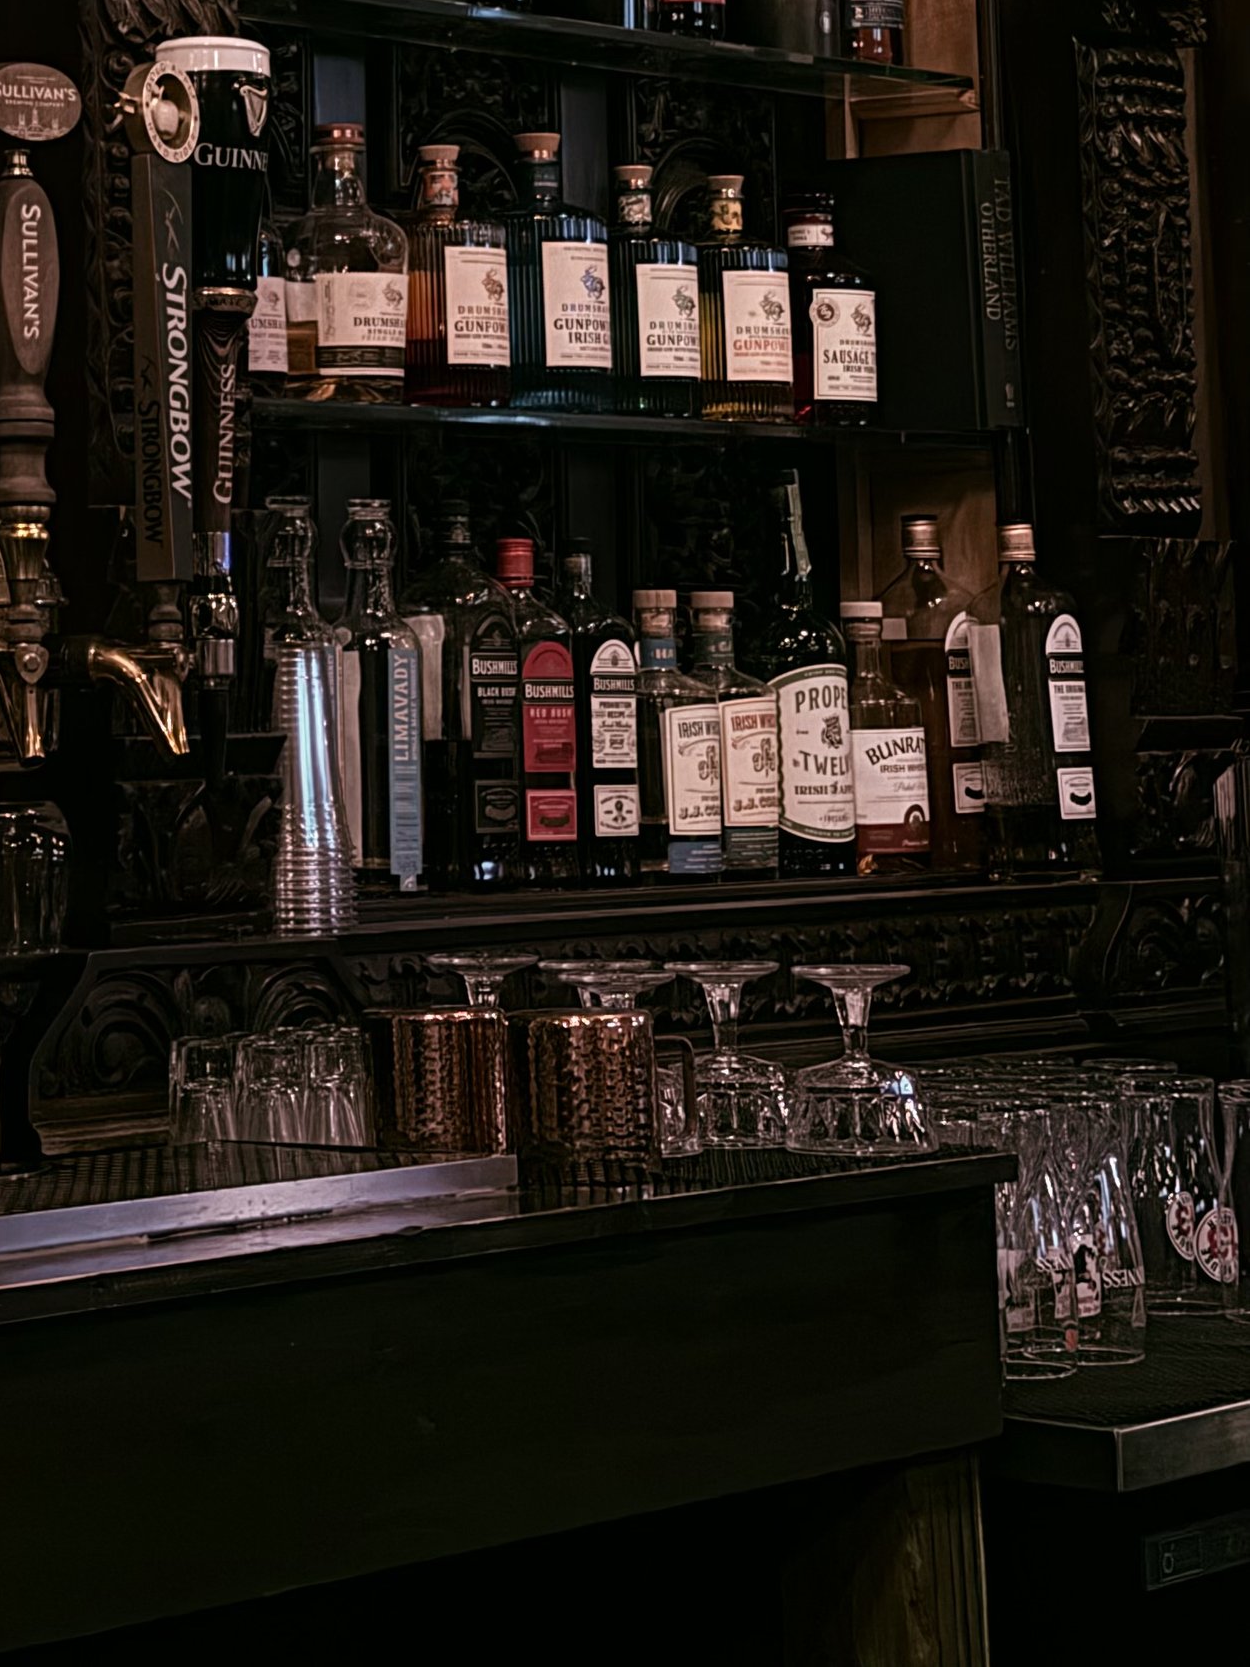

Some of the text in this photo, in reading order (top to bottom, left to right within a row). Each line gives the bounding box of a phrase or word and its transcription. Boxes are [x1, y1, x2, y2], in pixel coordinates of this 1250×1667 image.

[980, 200, 1003, 323] OTHERLAND
[20, 203, 42, 340] SULLIVAN'S
[568, 331, 602, 344] IRISH
[823, 349, 870, 365] SAUSAGE
[842, 363, 863, 374] IRISH
[162, 262, 193, 502] STRONGBOW
[212, 363, 236, 505] GUINNESS
[136, 398, 164, 549] STRONGBOW
[472, 658, 518, 675] BUSHMILLS
[477, 686, 500, 698] BLACK
[525, 683, 575, 699] BUSHMILLS
[593, 677, 635, 692] BUSHMILLS
[1053, 684, 1064, 694] THE
[393, 653, 410, 763] LIMAVADY
[530, 707, 572, 718] RED BUSH
[607, 710, 626, 719] RECIPE
[678, 721, 704, 739] IRISH
[731, 714, 758, 732] IRISH
[879, 764, 906, 774] IRISH
[794, 785, 829, 796] IRISH
